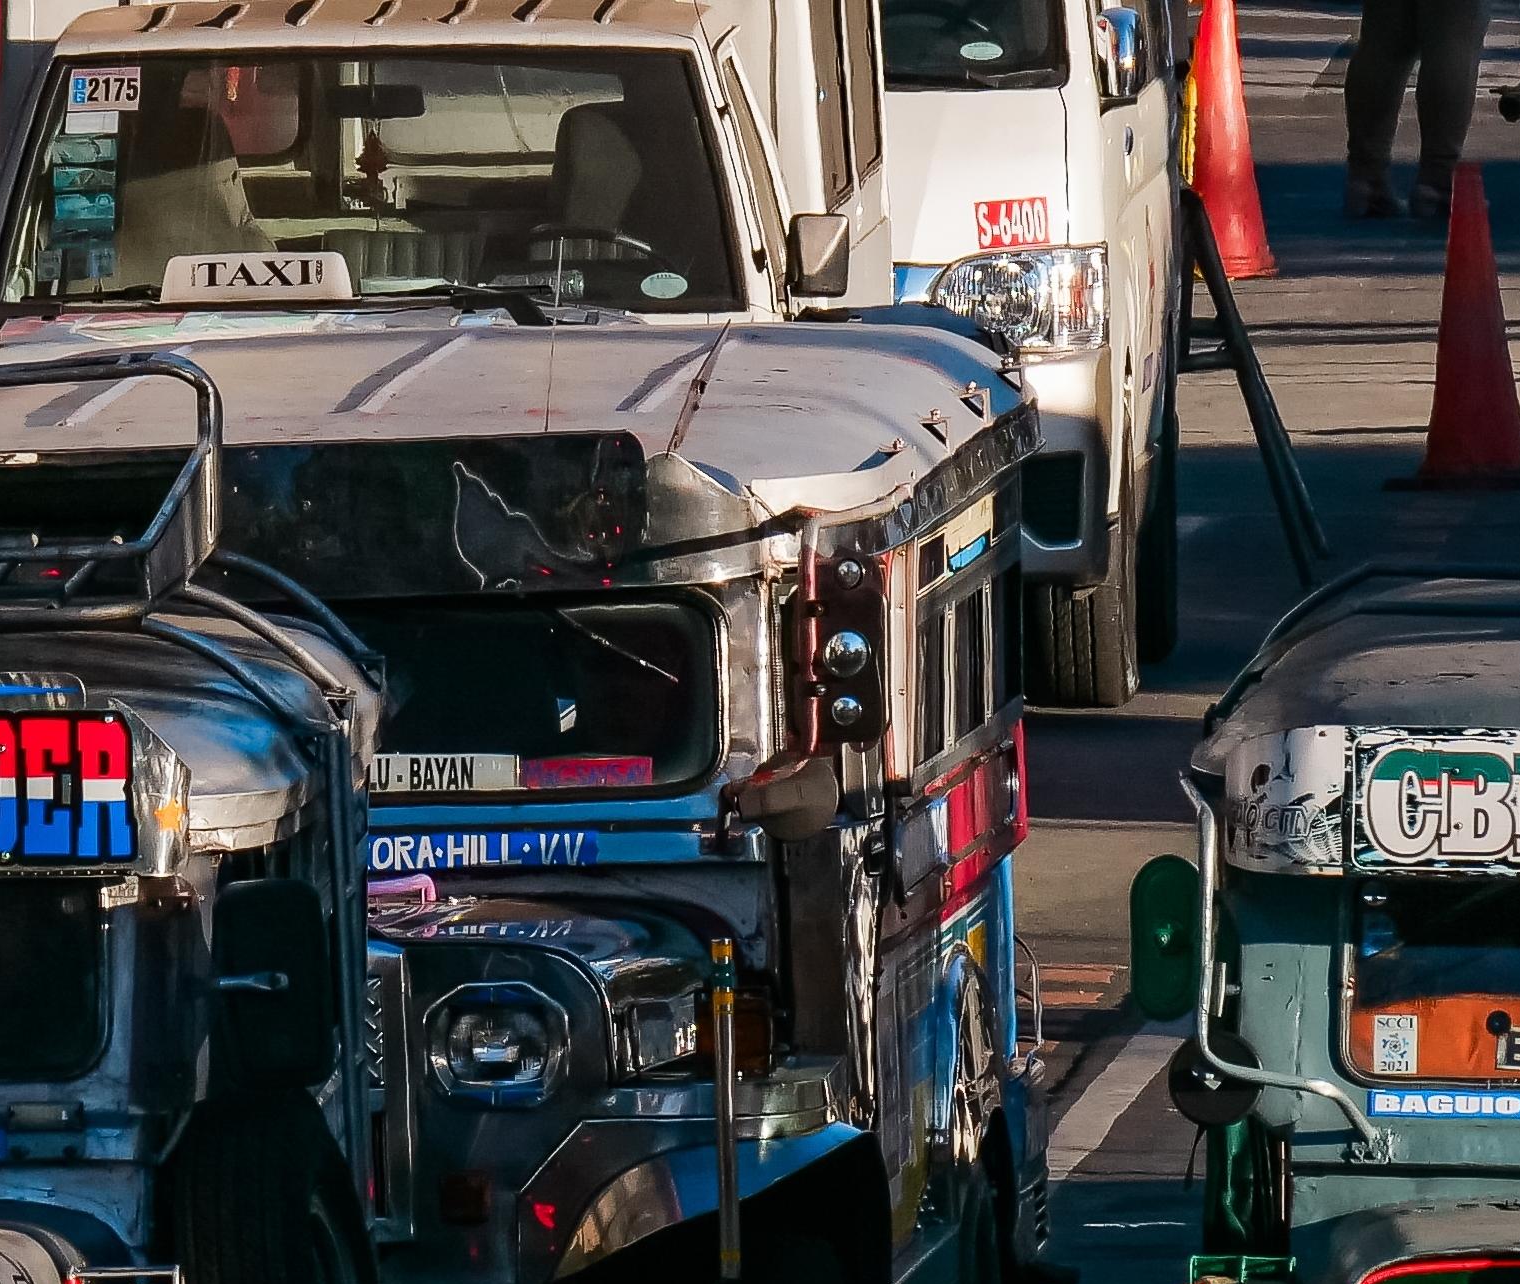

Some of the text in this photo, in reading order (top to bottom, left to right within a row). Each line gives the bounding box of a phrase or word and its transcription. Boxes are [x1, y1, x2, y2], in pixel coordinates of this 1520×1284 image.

[86, 77, 139, 102] 2175
[976, 198, 1046, 246] S-6400
[197, 259, 315, 288] TAXI
[409, 757, 475, 791] BAYAN
[447, 833, 522, 868] HILL
[1377, 1017, 1414, 1030] SCCI
[1379, 1060, 1410, 1072] 2021
